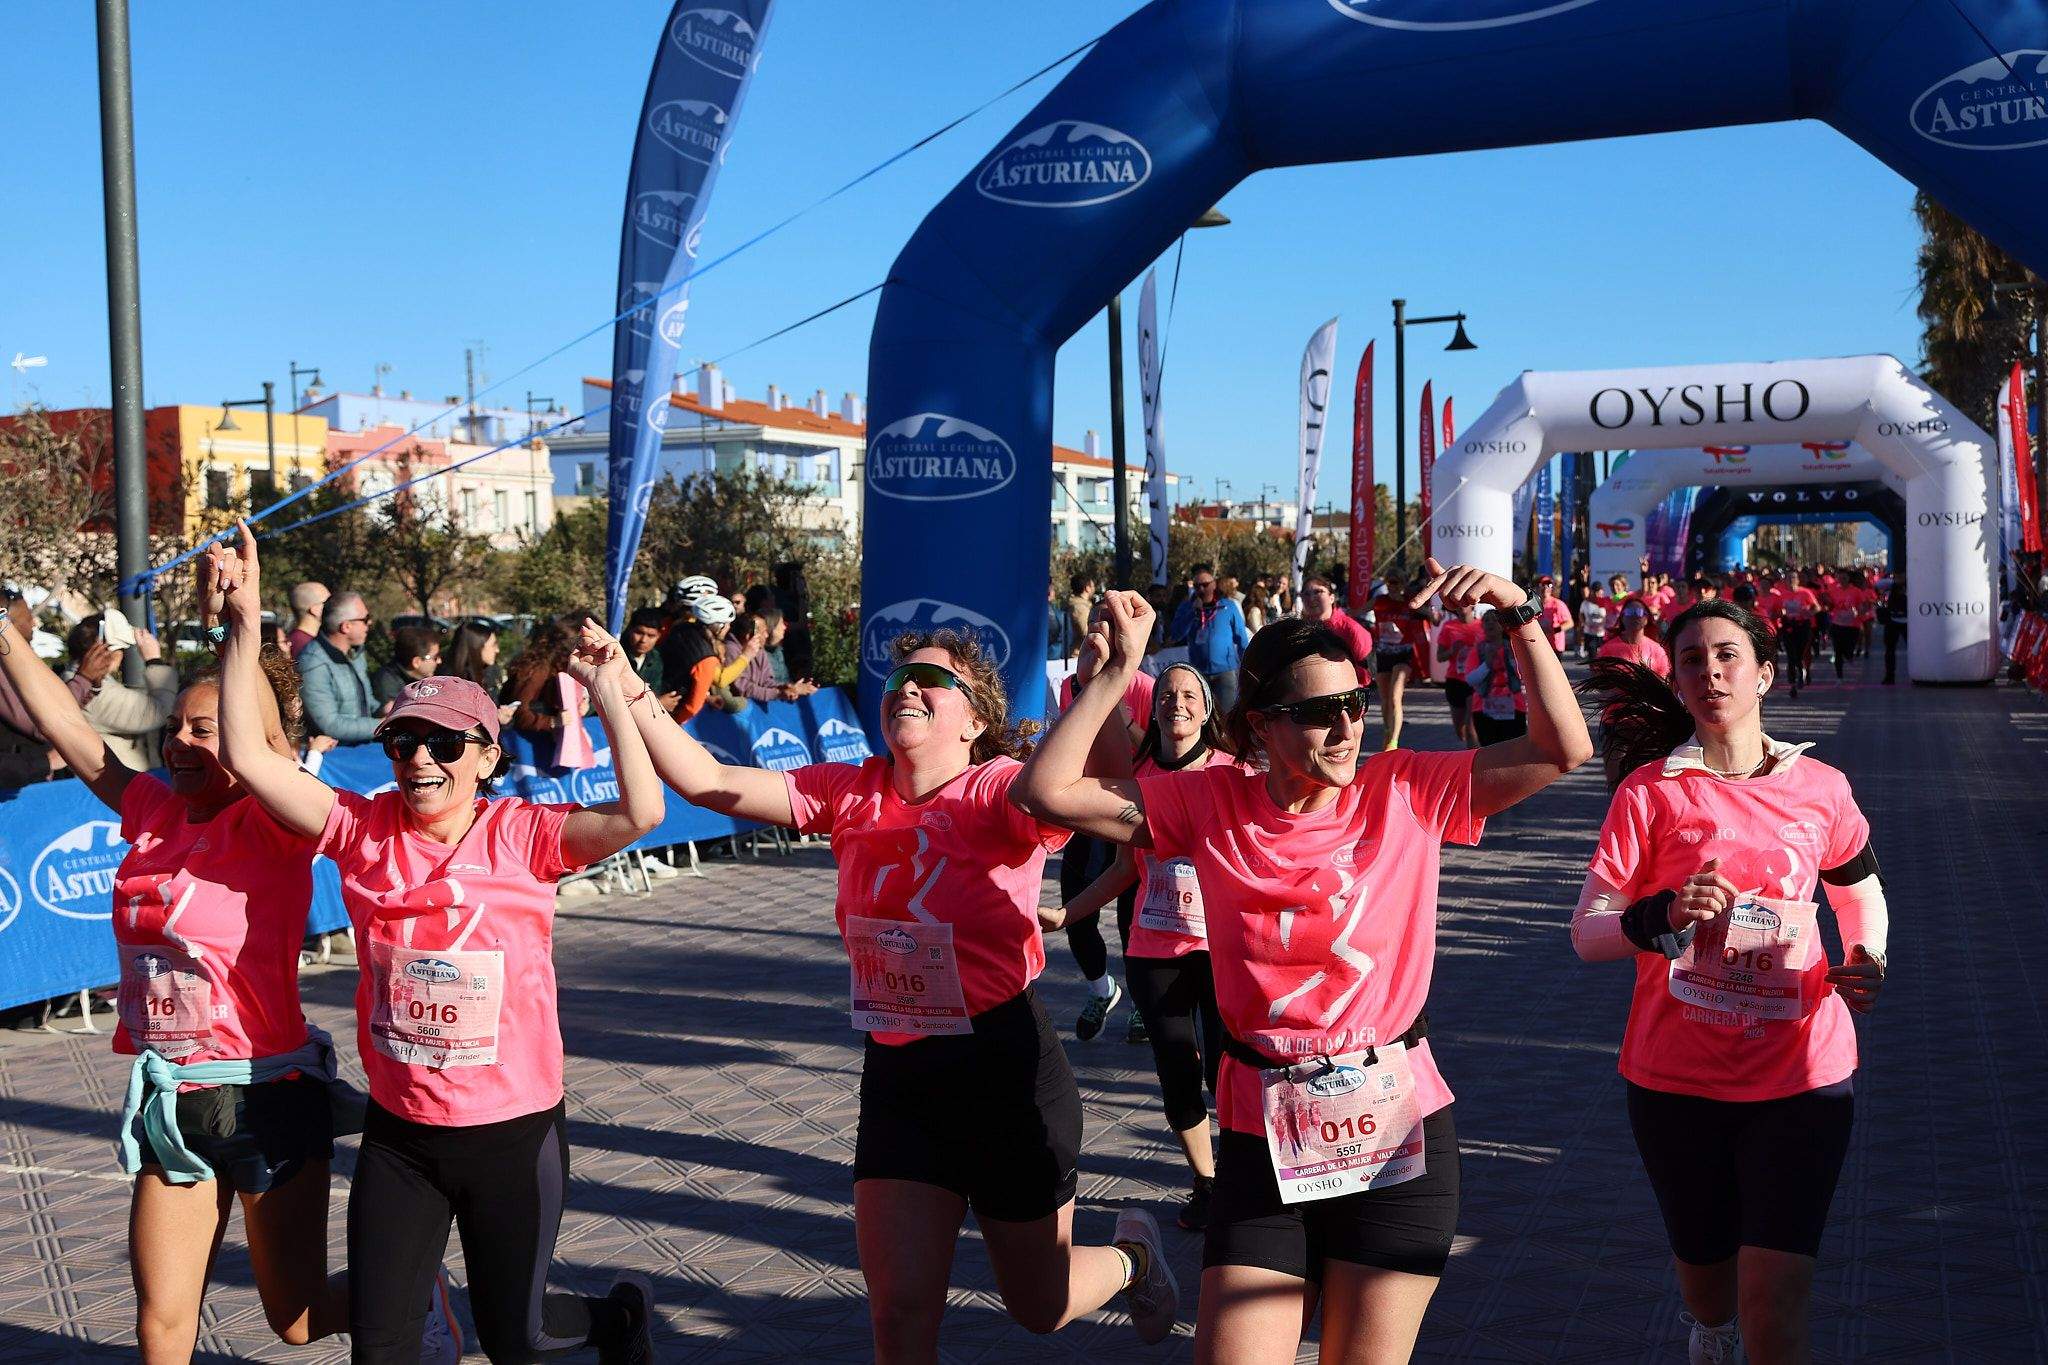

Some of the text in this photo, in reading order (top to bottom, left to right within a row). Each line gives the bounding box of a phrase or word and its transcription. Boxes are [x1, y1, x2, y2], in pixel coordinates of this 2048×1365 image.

[985, 159, 1137, 189] ASTURIANA
[1589, 379, 1810, 429] OYSHO
[1878, 418, 1949, 437] OYSHO
[1464, 440, 1526, 454] OYSHO
[871, 447, 1004, 480] ASTURIANA
[1748, 489, 1859, 503] VOLVO
[1918, 511, 1985, 527] OYSHO
[1437, 524, 1494, 540] OYSHO
[1918, 601, 1985, 616] OYSHO
[1678, 827, 1737, 844] OYHO
[1166, 890, 1193, 904] 016
[1730, 911, 1776, 927] ASTURIANA
[1722, 946, 1774, 971] 016
[409, 965, 457, 979] ASTURIANA
[1729, 971, 1754, 983] 2248
[885, 971, 926, 993] 016
[1687, 973, 1715, 987] CARRERA
[1716, 981, 1725, 989] DE
[1726, 982, 1734, 990] LA
[1683, 986, 1724, 1003] OYSHO
[408, 1000, 458, 1024] 016
[1682, 1005, 1739, 1026] CARRERA
[417, 1025, 440, 1037] 5600
[866, 1015, 958, 1030] OYSHO Santander
[425, 1038, 446, 1048] MUJER
[1296, 1037, 1314, 1054] DE
[1311, 1075, 1363, 1093] ASTURIANA
[1320, 1113, 1377, 1143] 016
[1336, 1143, 1363, 1157] 5597
[1294, 1164, 1327, 1177] CARRERA
[1327, 1162, 1337, 1170] DE
[1338, 1159, 1348, 1168] LA
[1348, 1155, 1372, 1167] MUJER
[1297, 1163, 1414, 1194] OYSHO Santander
